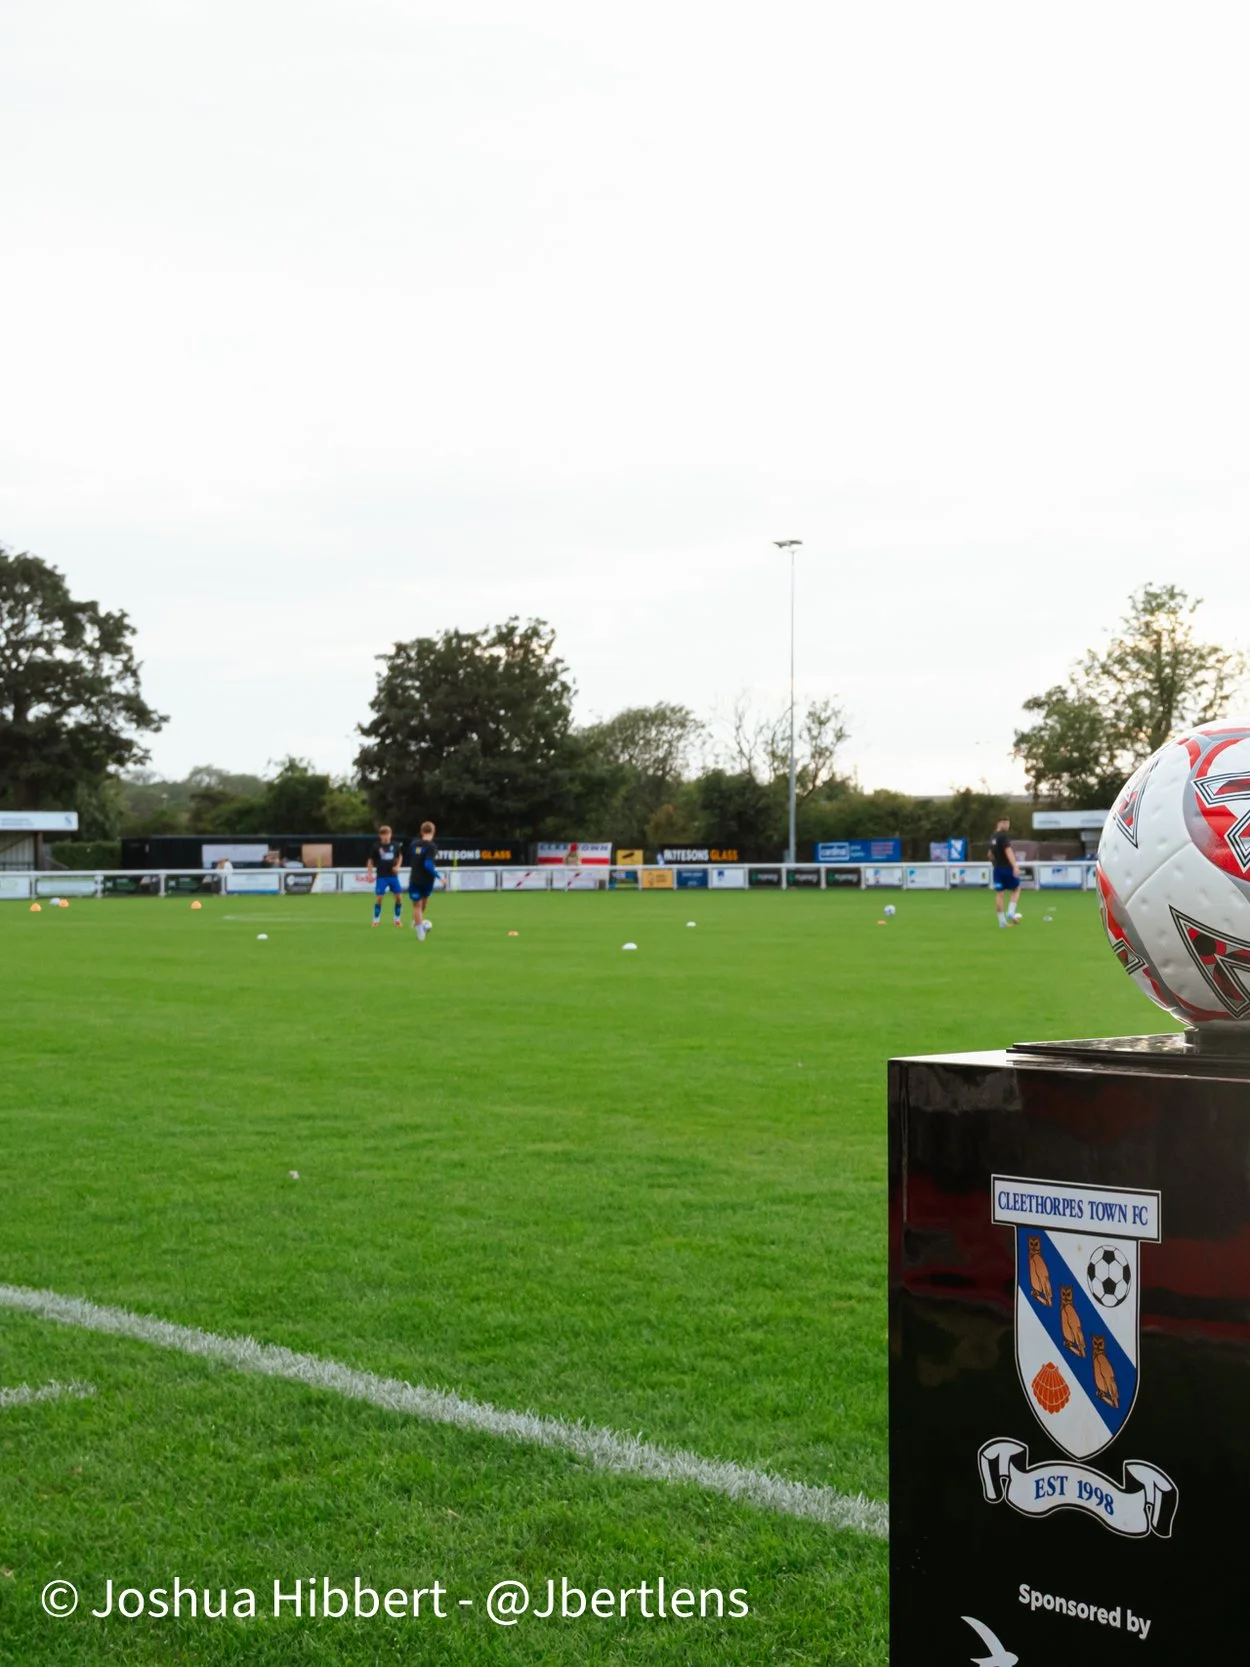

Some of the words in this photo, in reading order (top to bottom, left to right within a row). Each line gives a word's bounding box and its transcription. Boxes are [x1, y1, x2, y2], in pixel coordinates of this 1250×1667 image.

[481, 850, 512, 860] GLASS
[710, 849, 738, 861] GLASS
[998, 1190, 1084, 1219] CLEETHORPES
[1088, 1200, 1127, 1223] TOWN
[1132, 1205, 1148, 1226] FC
[1034, 1475, 1068, 1500] EST
[1077, 1480, 1114, 1516] 1998
[1018, 1583, 1121, 1628] Sponsored
[1126, 1609, 1151, 1640] by
